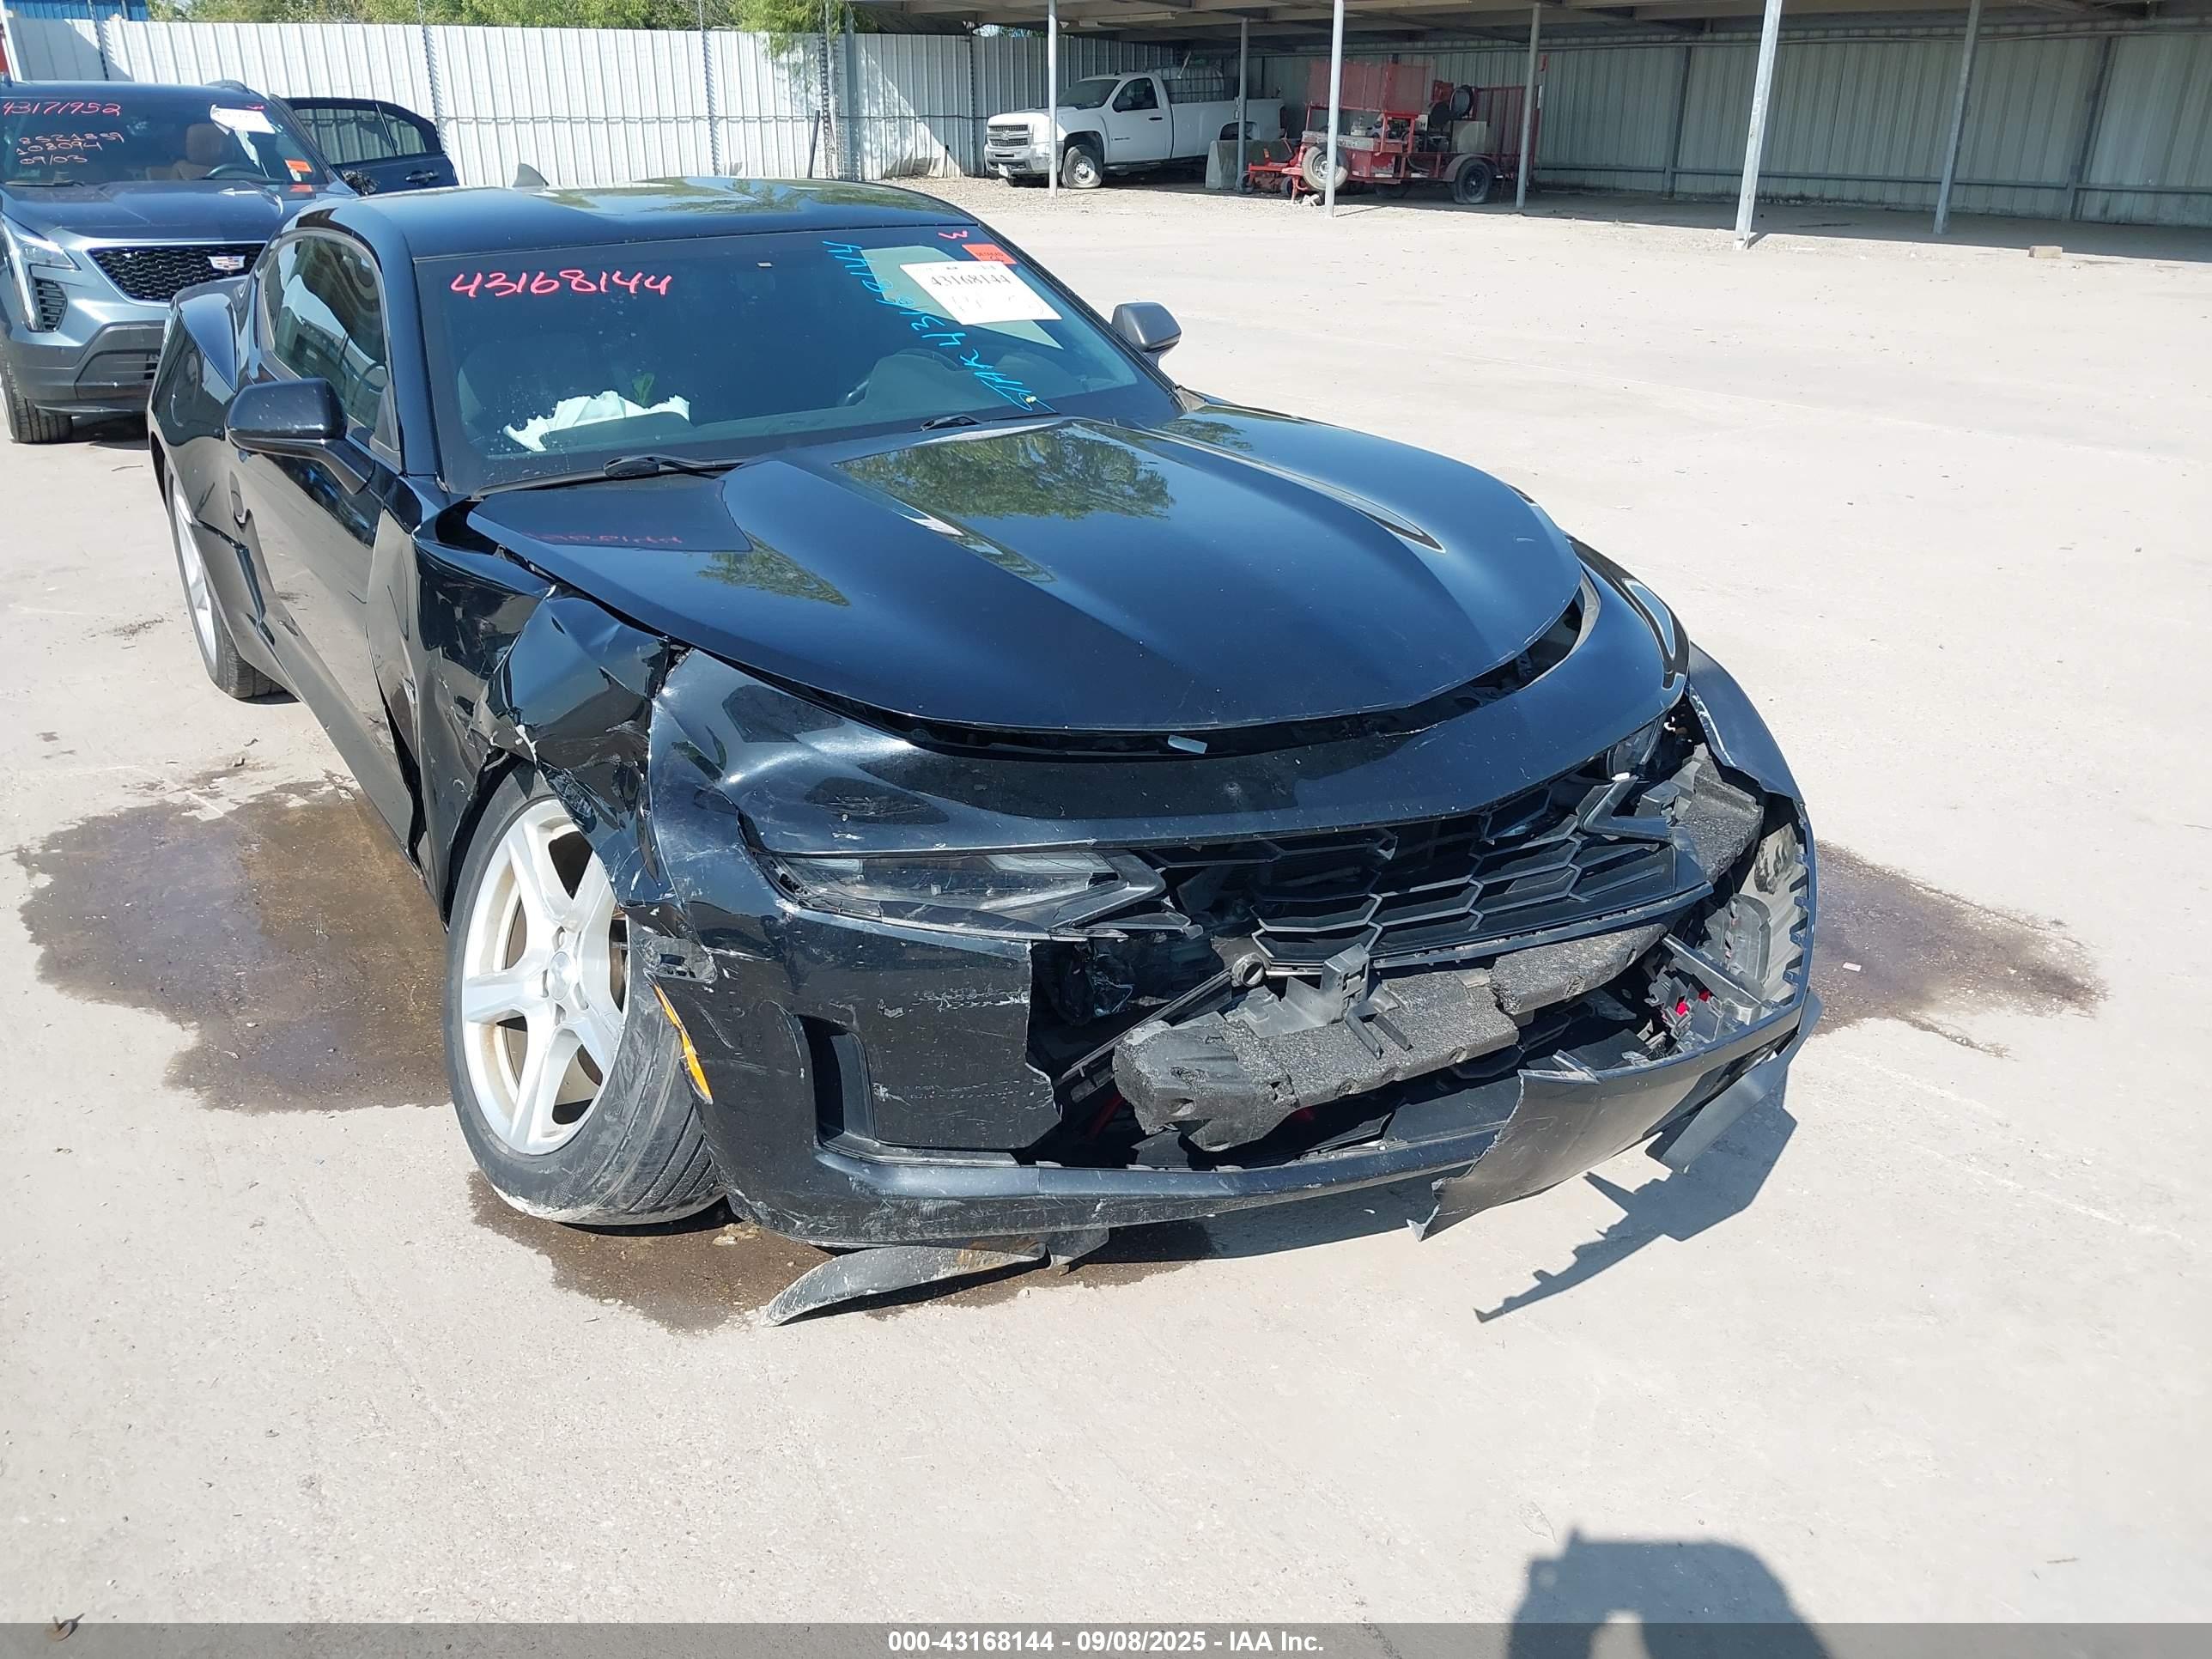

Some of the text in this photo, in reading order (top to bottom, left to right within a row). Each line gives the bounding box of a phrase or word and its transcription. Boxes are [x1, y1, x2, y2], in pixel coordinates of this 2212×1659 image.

[3, 101, 121, 117] 43171952
[20, 154, 88, 166] 09/03
[449, 269, 673, 298] 43168144
[930, 273, 1012, 287] 43168144
